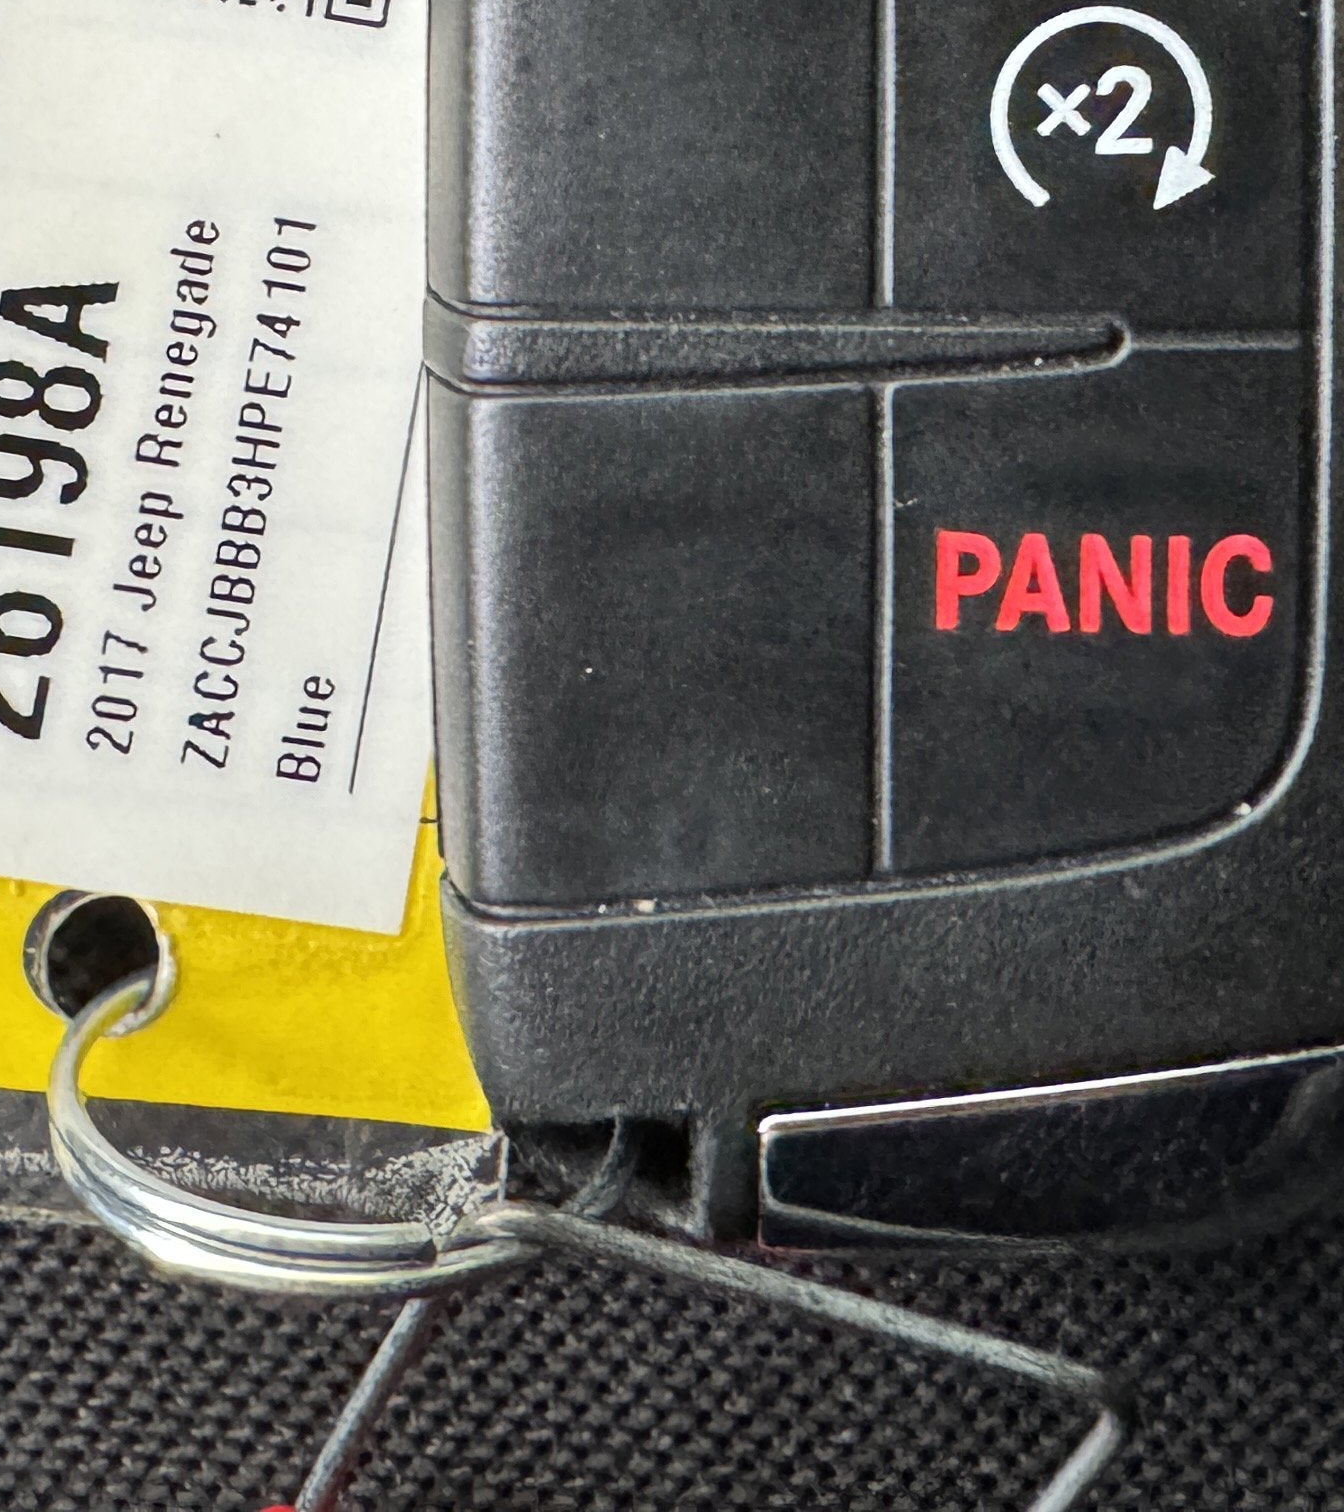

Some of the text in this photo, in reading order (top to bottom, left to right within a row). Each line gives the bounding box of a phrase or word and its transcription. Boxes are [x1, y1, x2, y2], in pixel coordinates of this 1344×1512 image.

[85, 219, 222, 756] 2017 Jeep Renegade
[180, 216, 318, 770] ZACCJBBB3HPE74101
[934, 528, 1274, 637] PANIC
[275, 674, 337, 784] Blue
